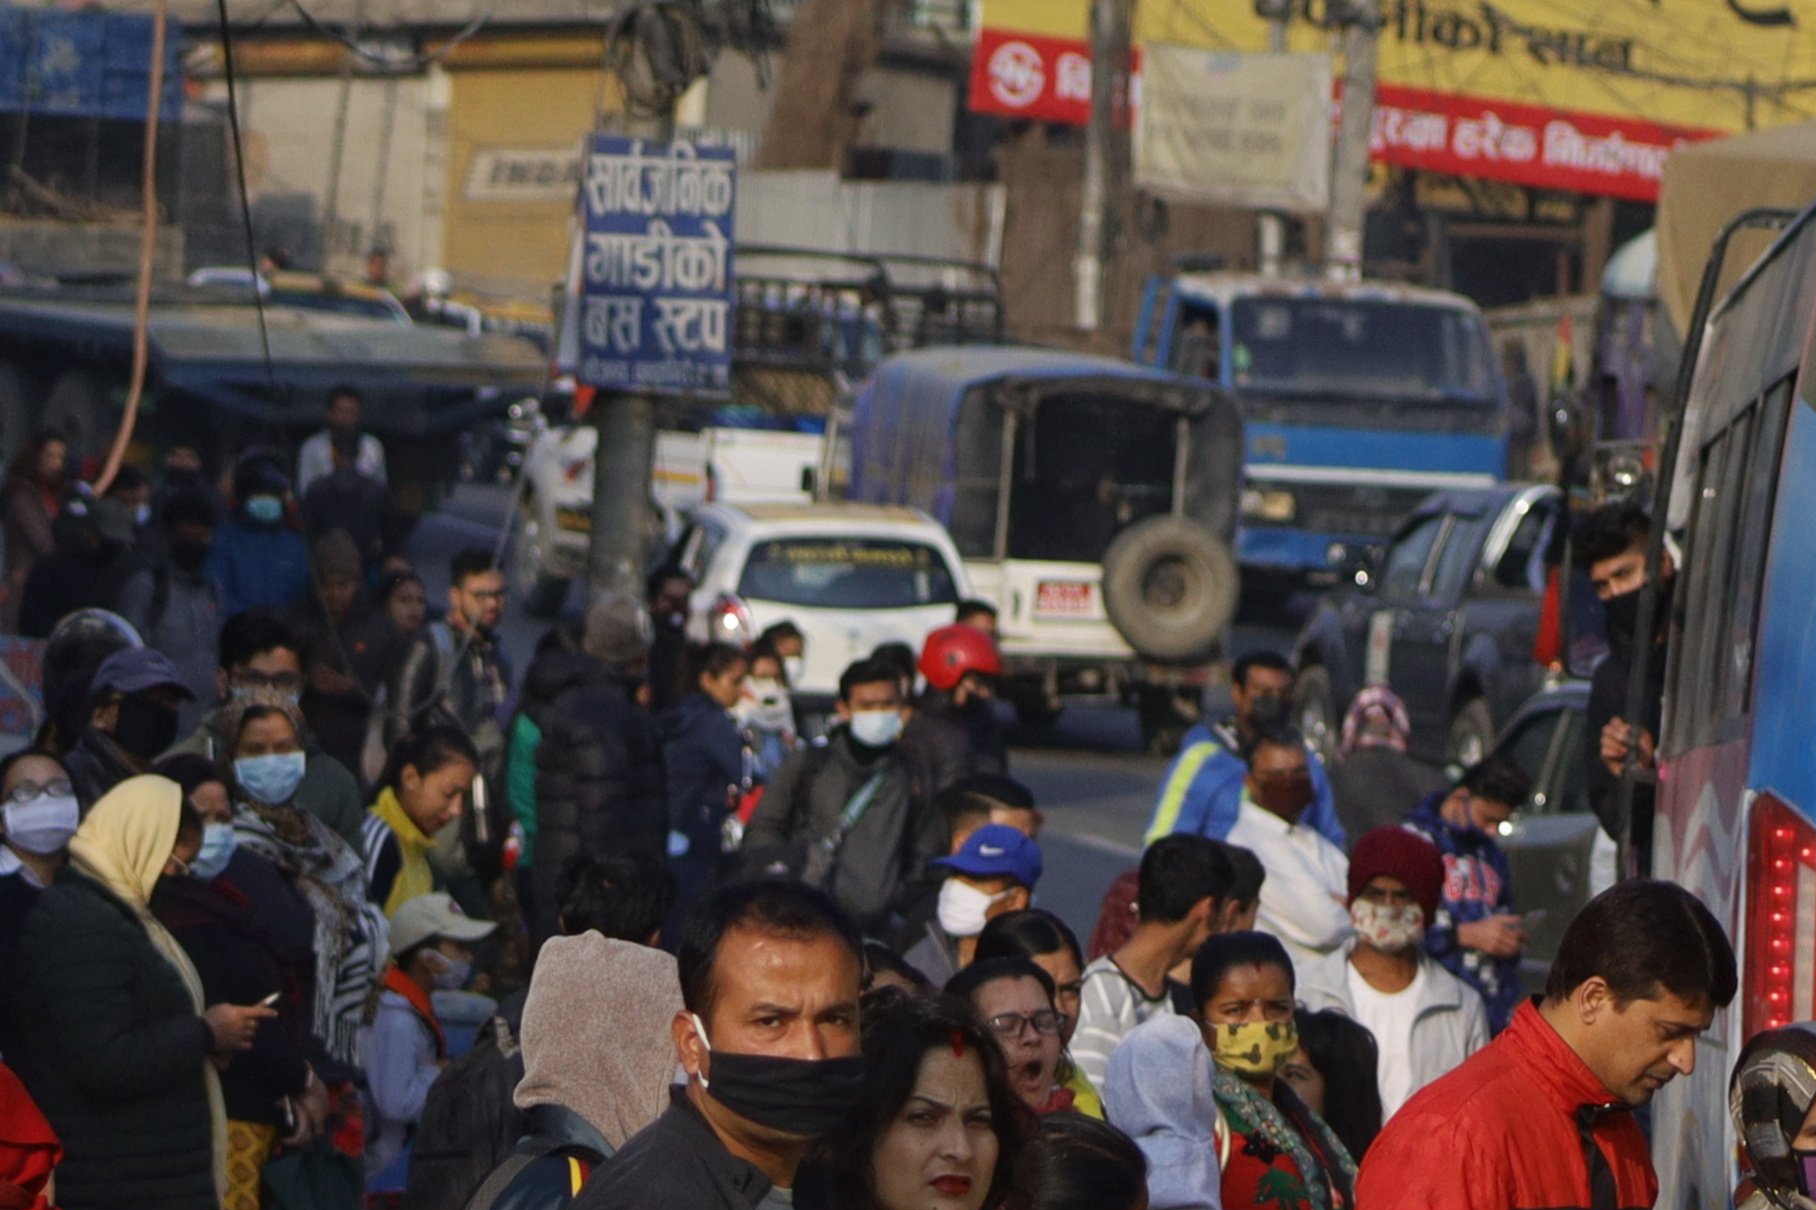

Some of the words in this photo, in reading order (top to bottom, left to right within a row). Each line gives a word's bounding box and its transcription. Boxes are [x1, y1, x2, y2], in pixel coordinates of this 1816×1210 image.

[587, 139, 735, 217] सार्वजनिक
[586, 218, 730, 291] गाडीको
[651, 298, 730, 353] स्टप
